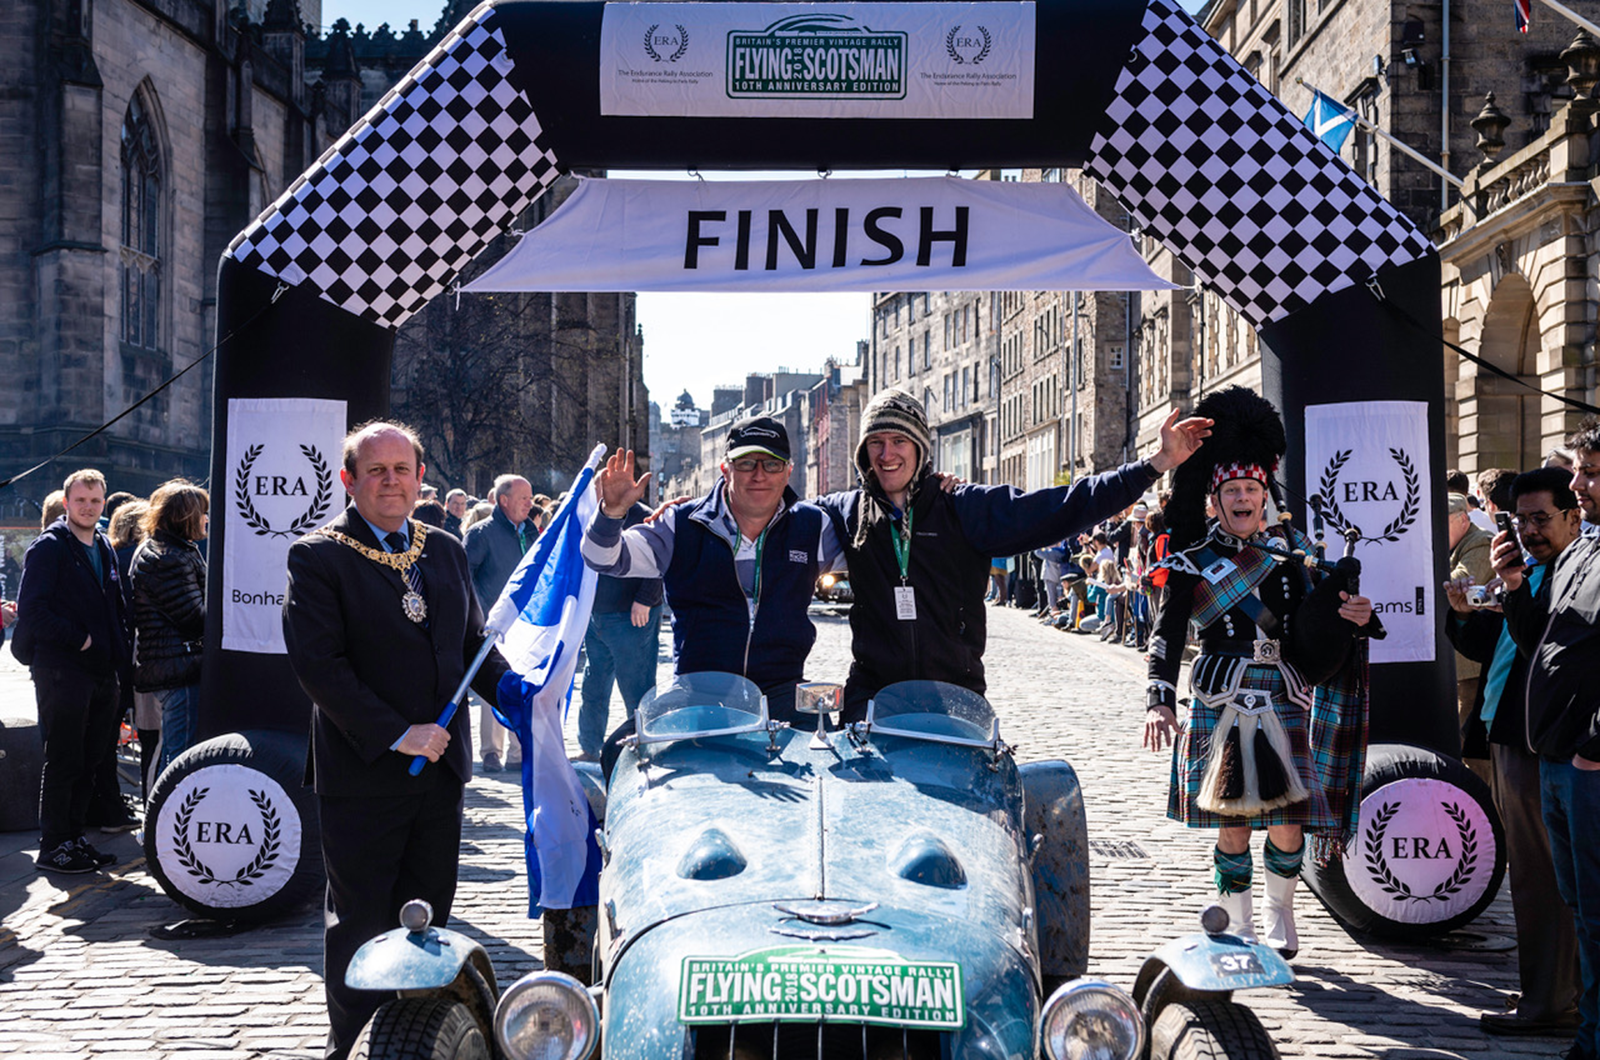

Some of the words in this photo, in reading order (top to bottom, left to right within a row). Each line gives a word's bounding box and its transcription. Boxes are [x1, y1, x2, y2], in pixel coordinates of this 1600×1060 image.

[654, 36, 678, 46] ERA
[956, 38, 981, 47] ERA
[735, 48, 792, 79] FLYING
[803, 48, 899, 80] SCOTSMAN
[793, 47, 802, 79] 2018
[735, 81, 762, 90] 10TH
[768, 82, 847, 91] ANNIVERSARY
[853, 82, 899, 91] EDITION
[684, 206, 969, 270] FINISH
[255, 476, 309, 496] ERA
[1343, 481, 1400, 502] ERA
[195, 821, 255, 845] ERA
[1391, 837, 1454, 859] ERA
[692, 963, 764, 973] BRITAIN'S
[771, 963, 835, 974] PREMIER
[841, 965, 902, 976] VINTAGE
[908, 968, 952, 978] RALLY
[1220, 954, 1251, 971] 37
[690, 972, 782, 1003] FLYING
[800, 974, 953, 1009] SCOTSMAN
[785, 973, 798, 1002] 2018
[689, 1005, 732, 1015] 10TH
[743, 1004, 870, 1015] ANNIVERSARY
[881, 1006, 955, 1022] EDITION
